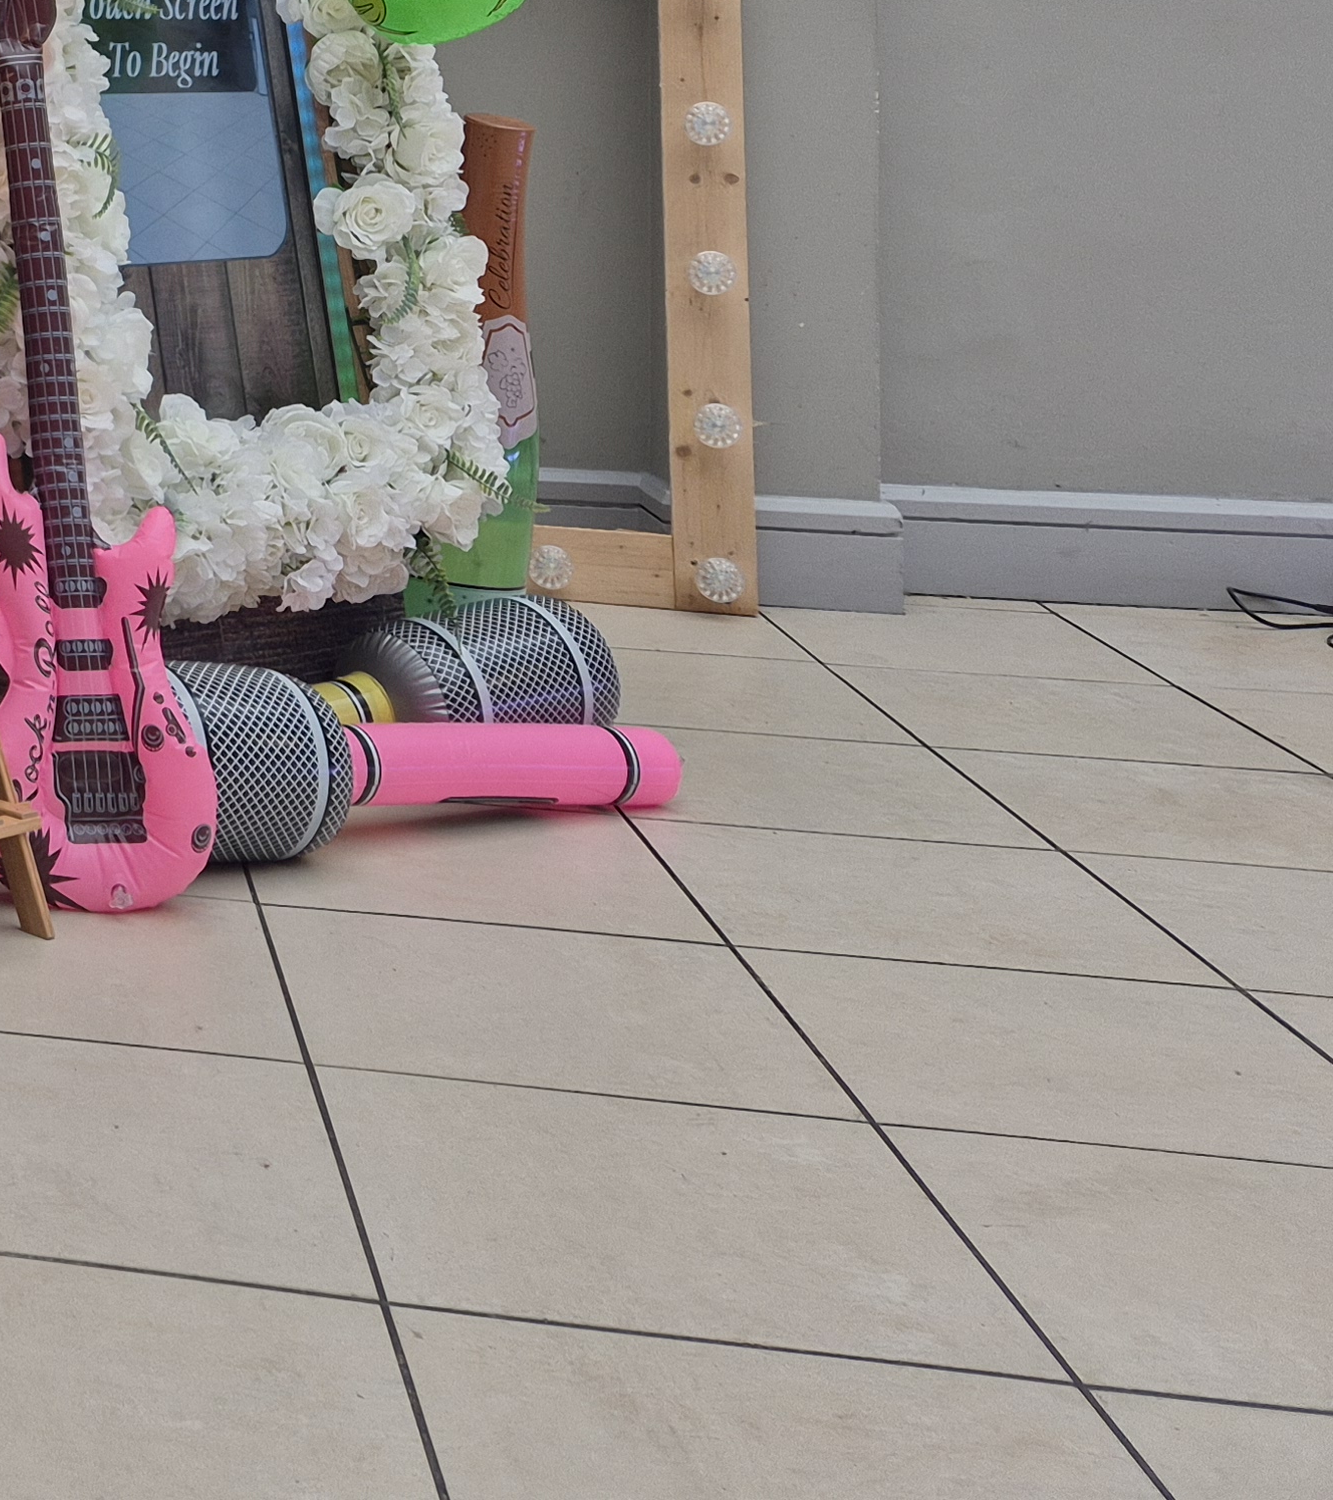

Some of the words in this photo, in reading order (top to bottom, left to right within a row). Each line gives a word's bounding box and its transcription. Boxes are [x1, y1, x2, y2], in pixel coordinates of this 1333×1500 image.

[109, 41, 142, 78] To
[149, 41, 220, 89] Begin
[488, 182, 515, 311] Celebration
